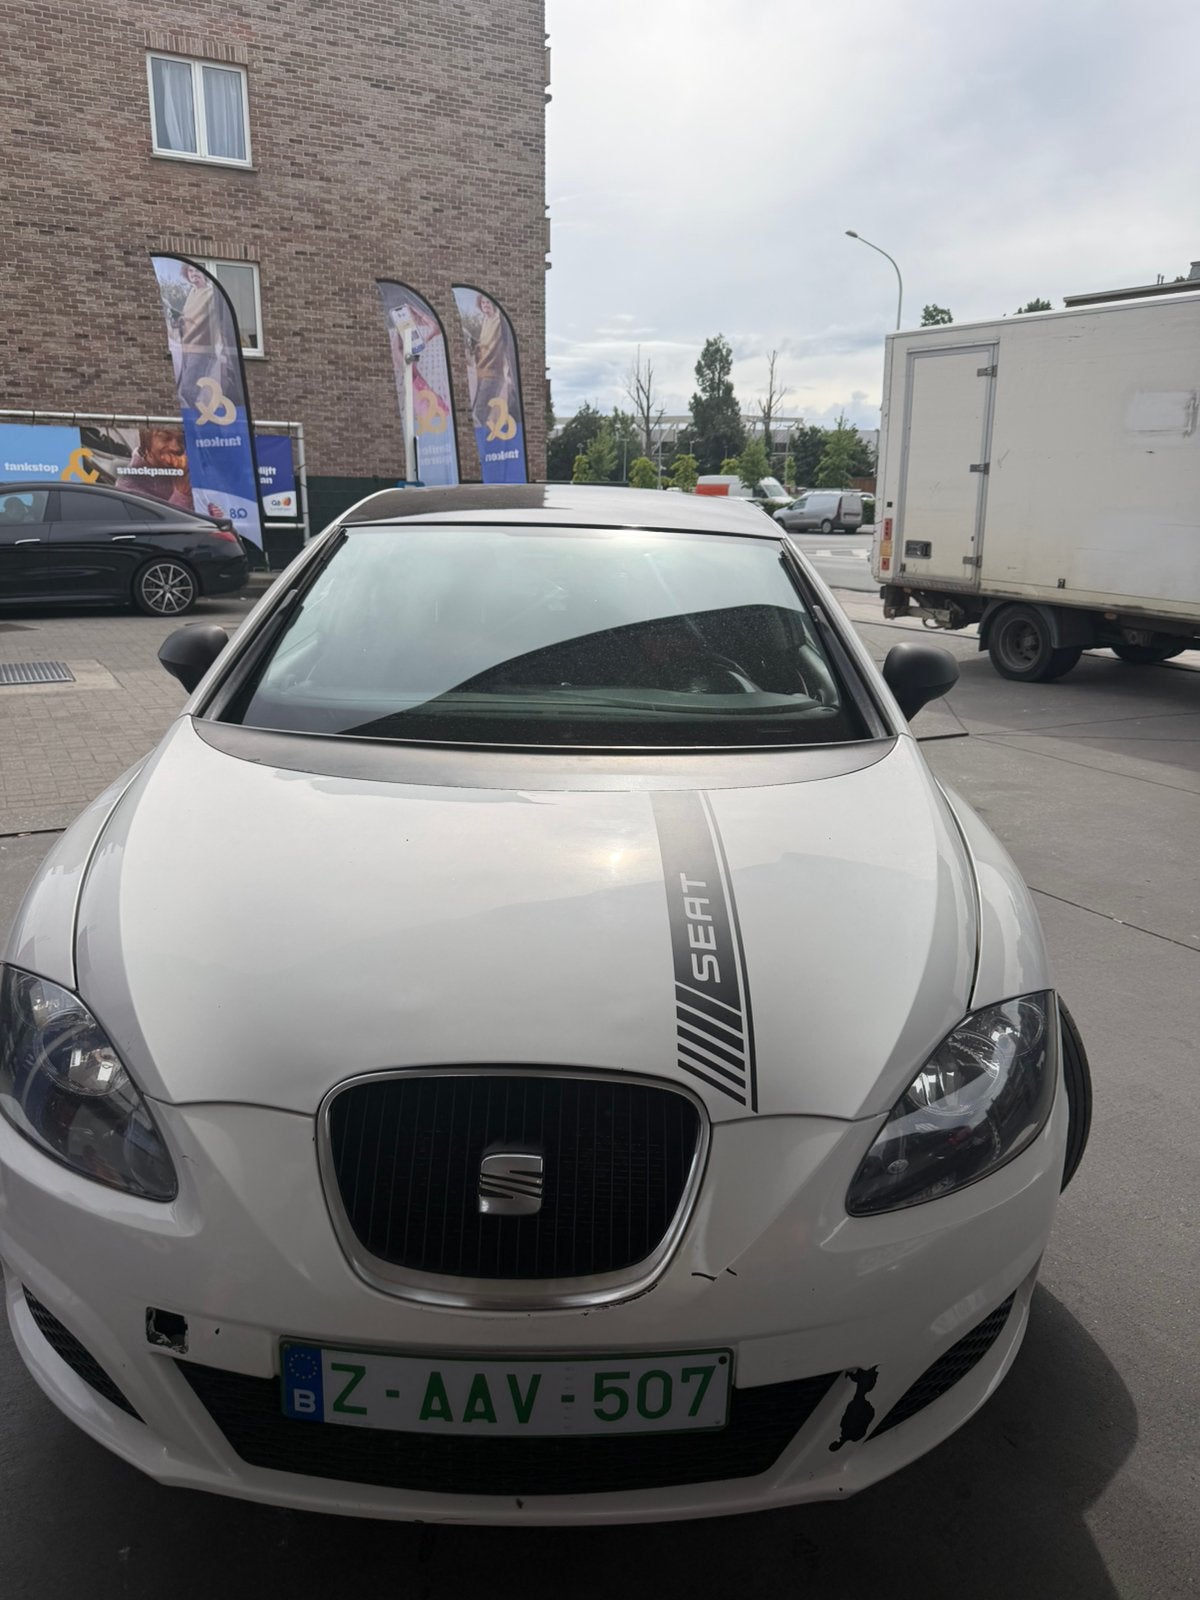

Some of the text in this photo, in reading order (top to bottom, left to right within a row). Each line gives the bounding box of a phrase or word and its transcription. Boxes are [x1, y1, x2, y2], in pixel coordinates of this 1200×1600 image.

[4, 462, 59, 474] tankstop
[116, 465, 184, 477] snackpauze
[680, 872, 721, 983] SEAT
[293, 1388, 316, 1413] B
